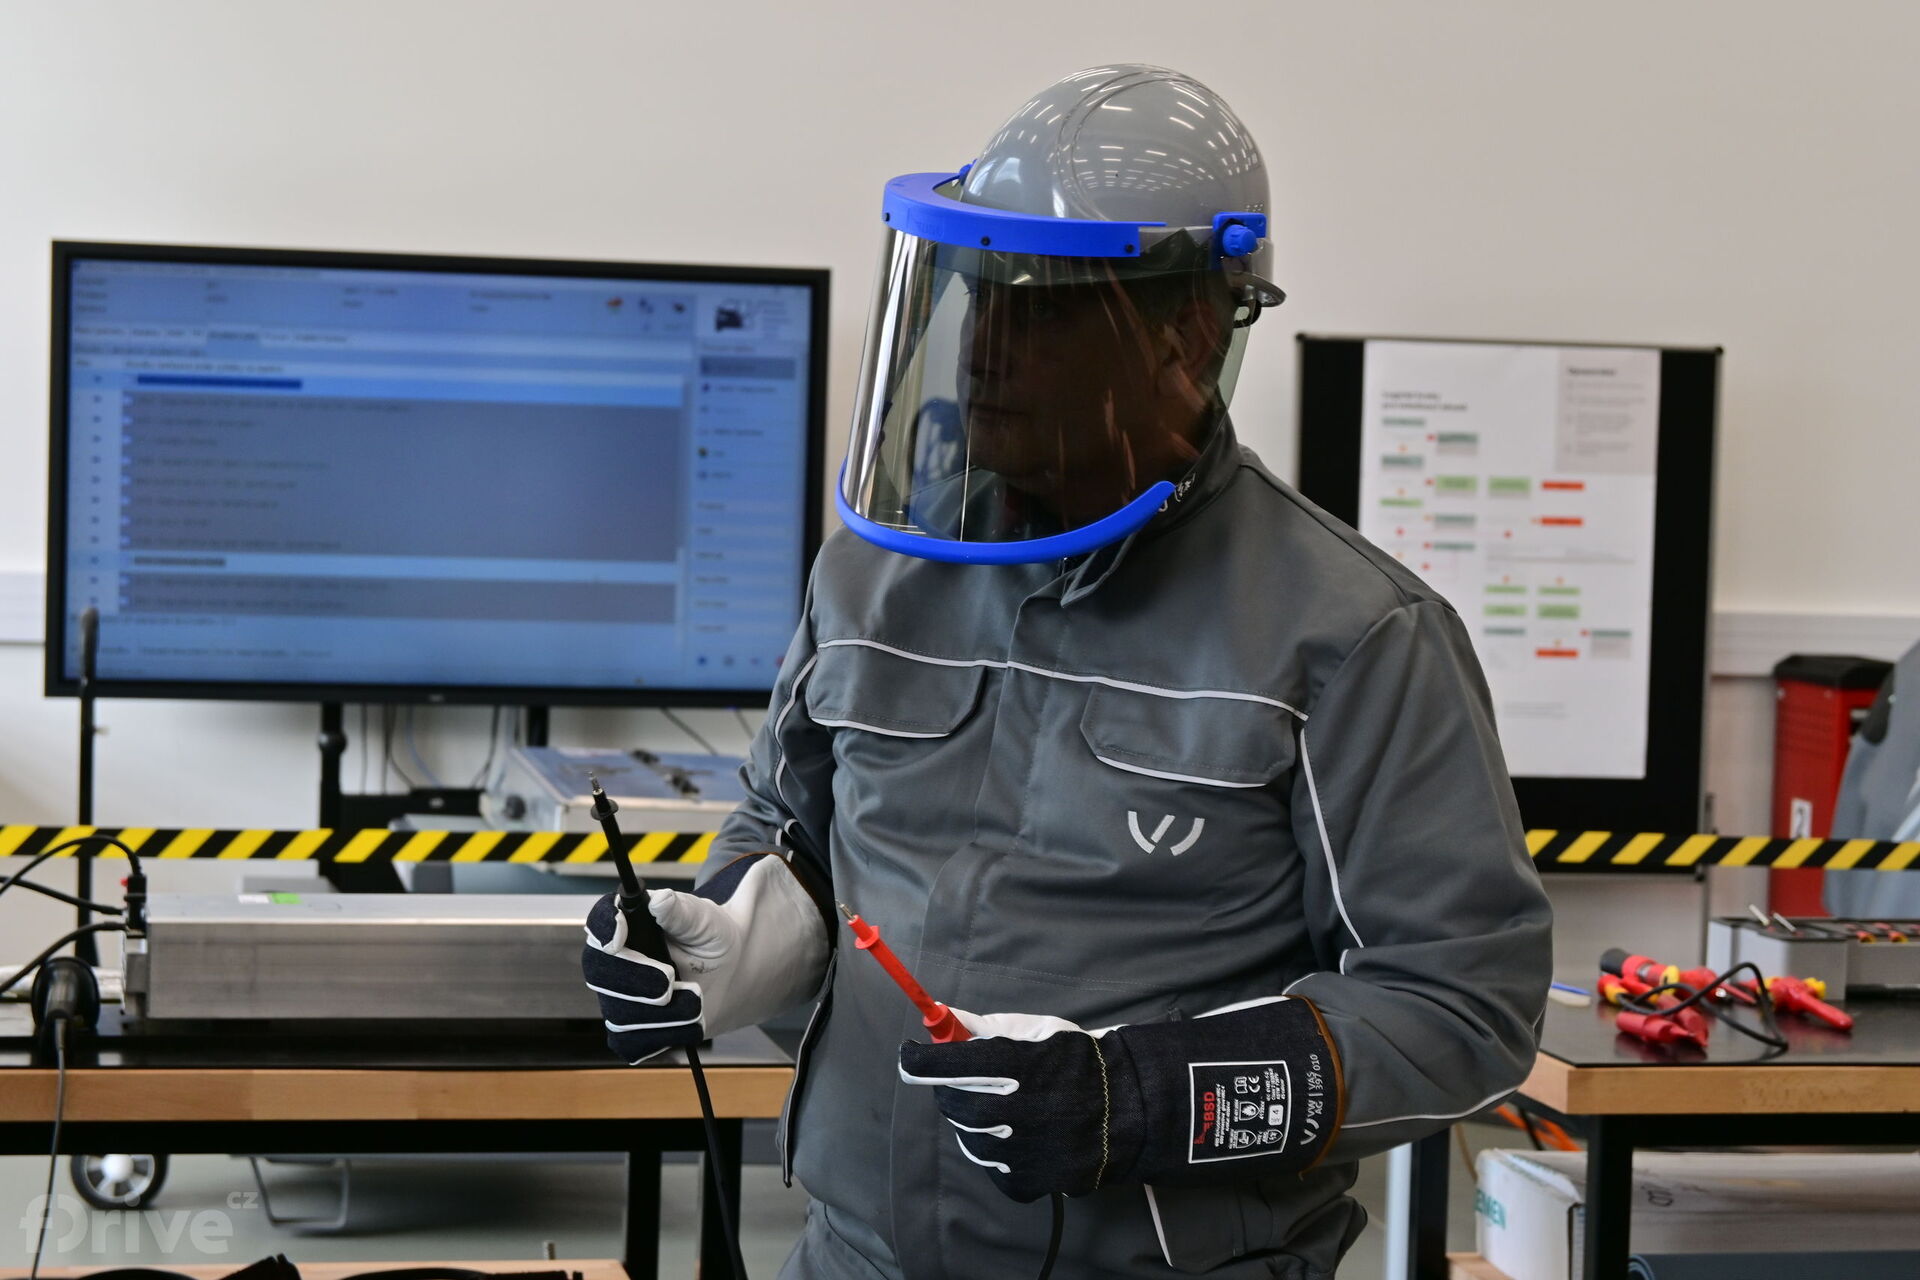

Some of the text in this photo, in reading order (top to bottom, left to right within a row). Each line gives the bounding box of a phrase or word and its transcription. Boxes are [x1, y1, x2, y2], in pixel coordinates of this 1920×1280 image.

[1204, 1091, 1215, 1120] BSD
[1306, 1072, 1316, 1118] VW VAS
[1310, 1054, 1324, 1114] AG 397 010
